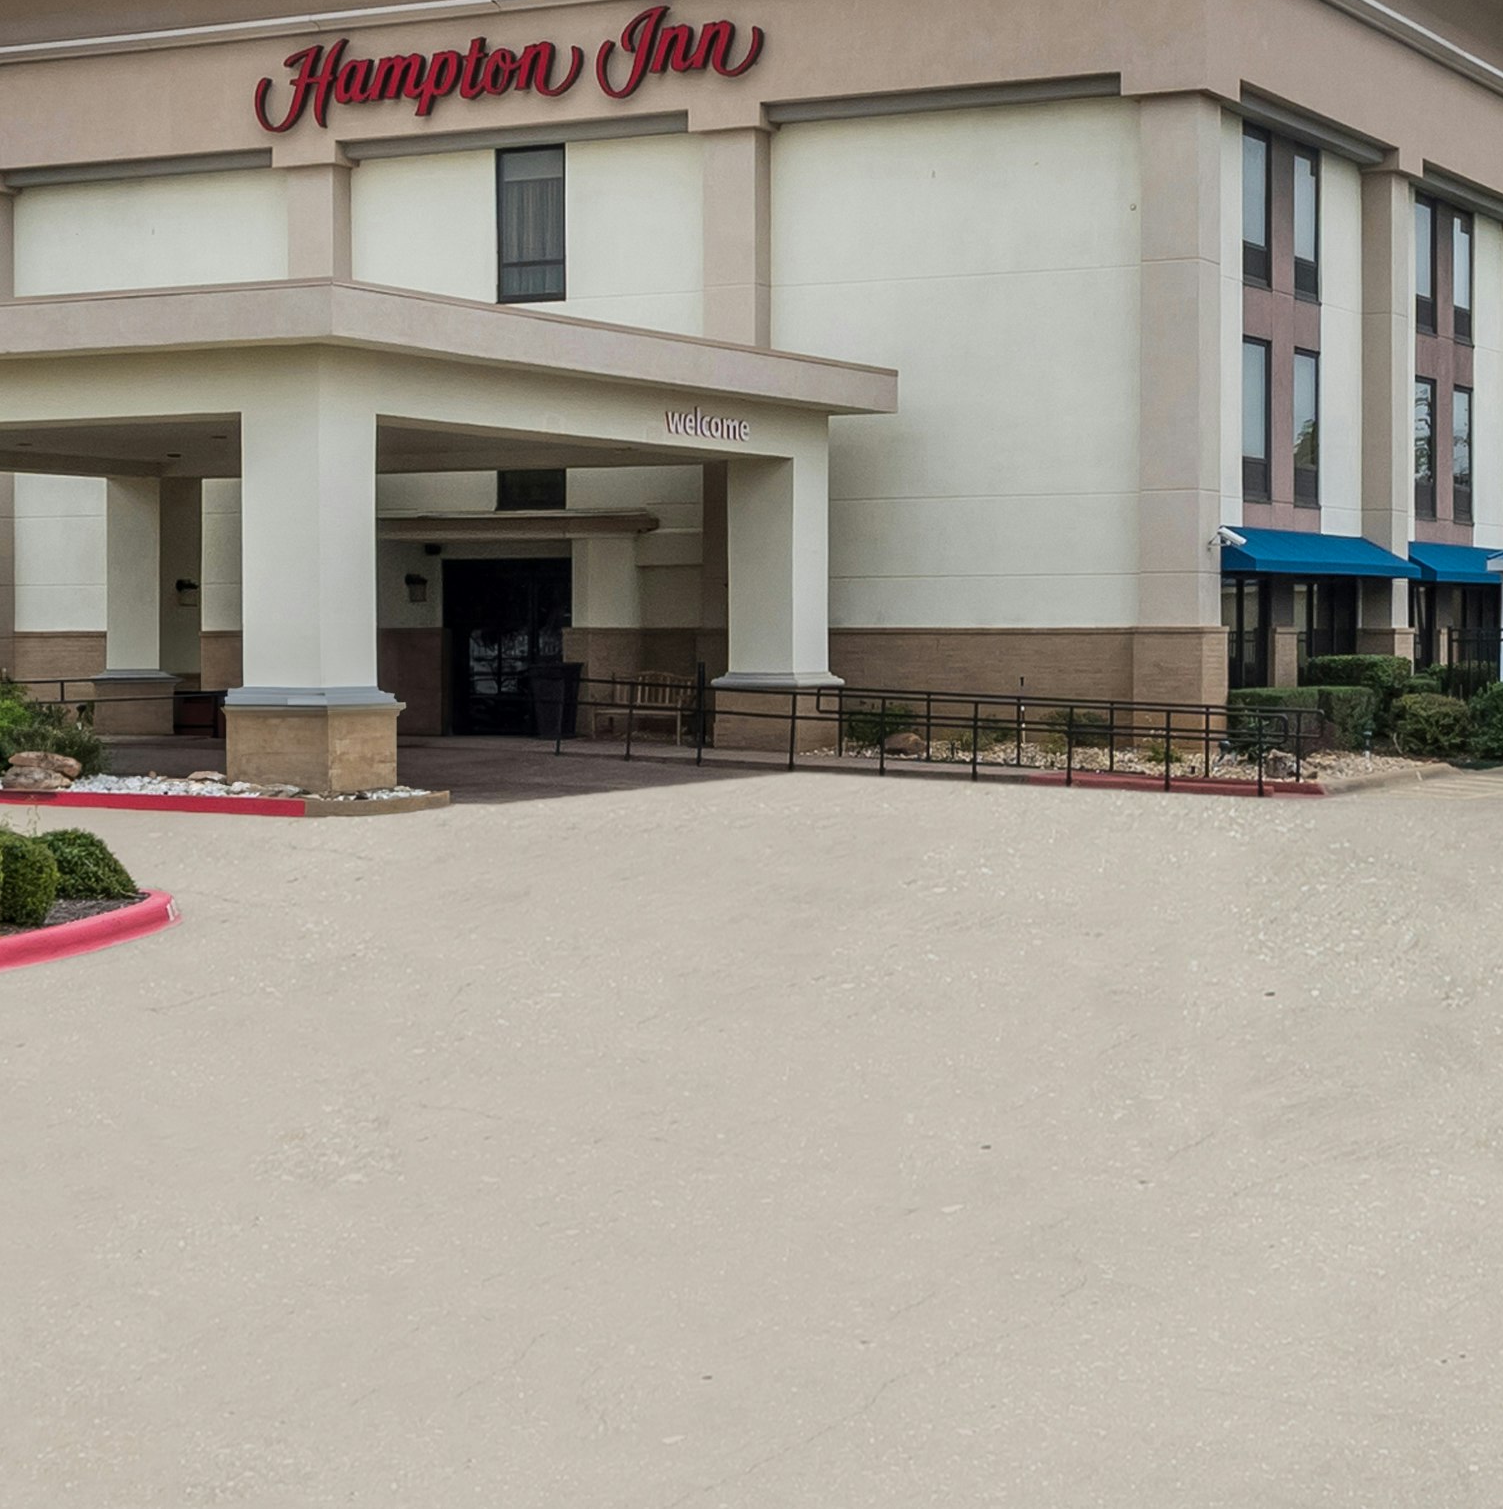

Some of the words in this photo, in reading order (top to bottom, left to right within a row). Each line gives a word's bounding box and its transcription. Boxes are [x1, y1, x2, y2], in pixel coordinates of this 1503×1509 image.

[255, 37, 583, 133] Hampton
[597, 6, 764, 99] Inn
[665, 406, 750, 441] welcome
